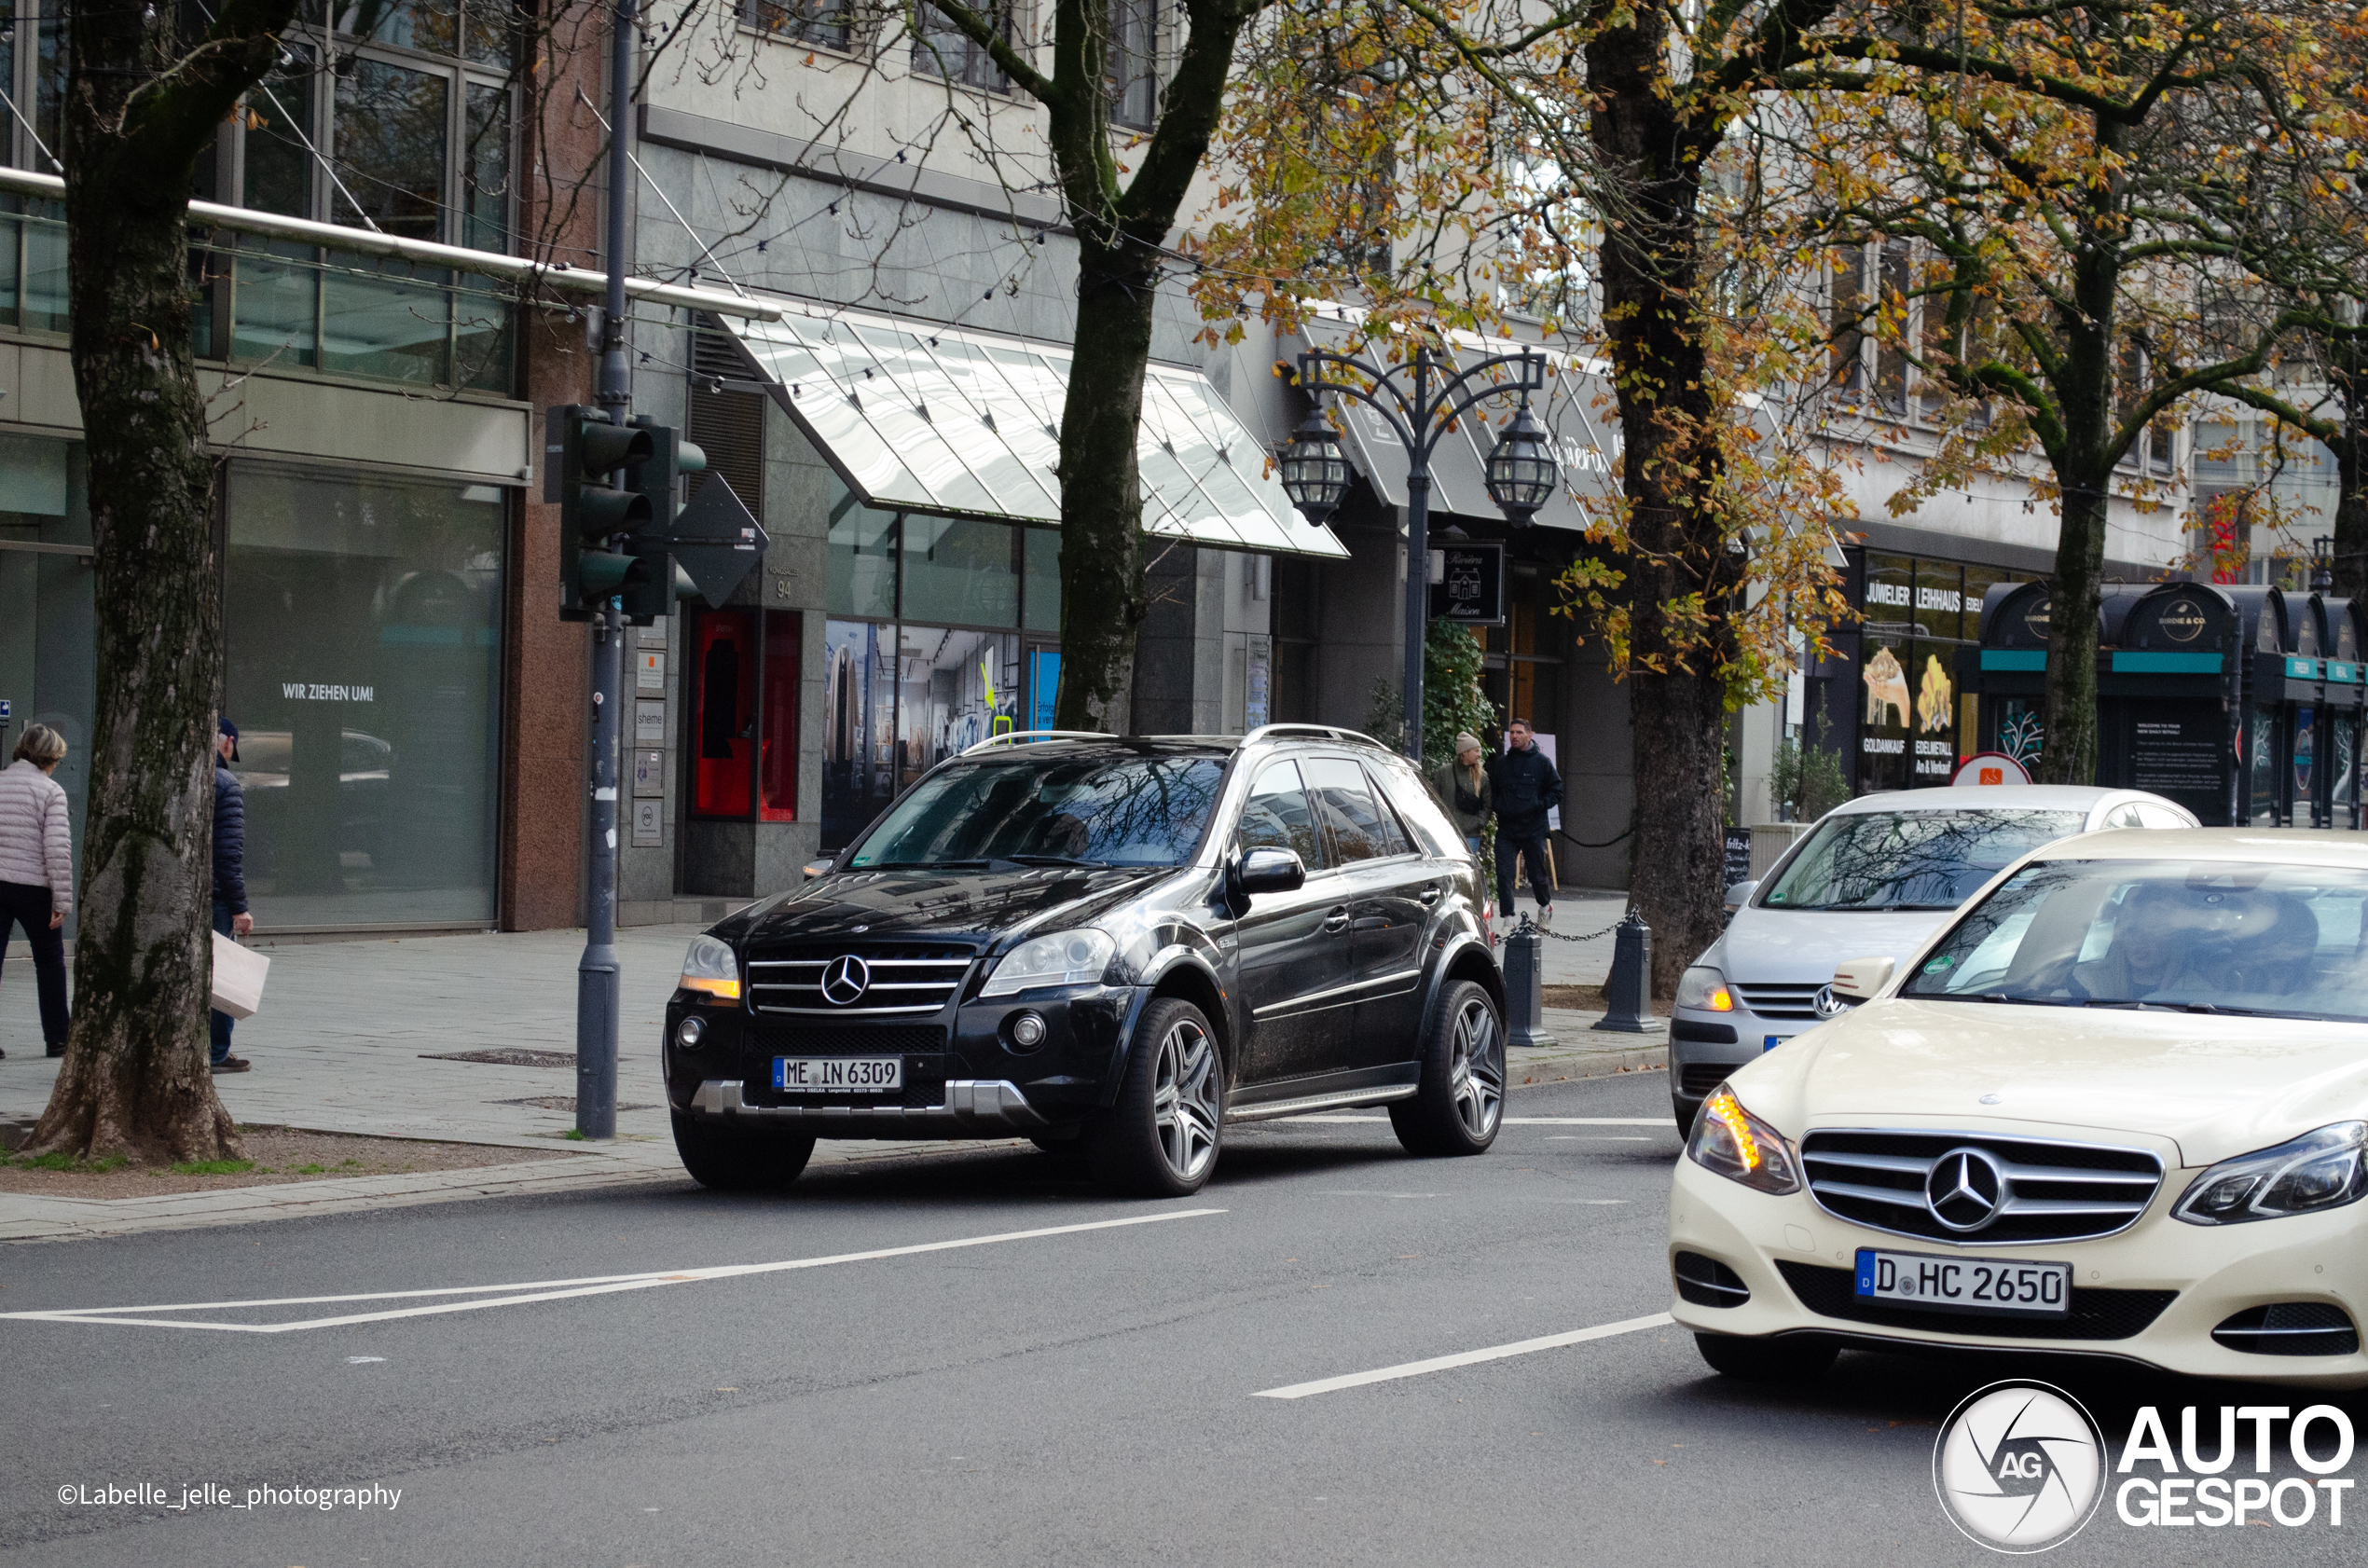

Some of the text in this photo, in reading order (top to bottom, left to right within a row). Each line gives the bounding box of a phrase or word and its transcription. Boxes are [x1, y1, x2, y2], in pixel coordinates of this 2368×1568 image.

[777, 580, 791, 598] 94
[1866, 582, 1910, 606] JUWELIER
[1916, 587, 1961, 612] LEIHHAUS
[1446, 601, 1480, 615] Maison
[2024, 614, 2050, 623] BIRDIE
[282, 682, 374, 702] WIR ZIEHEN UM!
[638, 712, 663, 724] sheme
[1864, 737, 1906, 754] GOLDANKAUF
[1915, 740, 1953, 756] EDELMETALL
[1916, 759, 1952, 775] An & Verkauf
[787, 1062, 808, 1084] ME
[821, 1062, 843, 1085] IN
[847, 1062, 896, 1084] 6309
[1862, 1258, 2062, 1304] D D HC 2650
